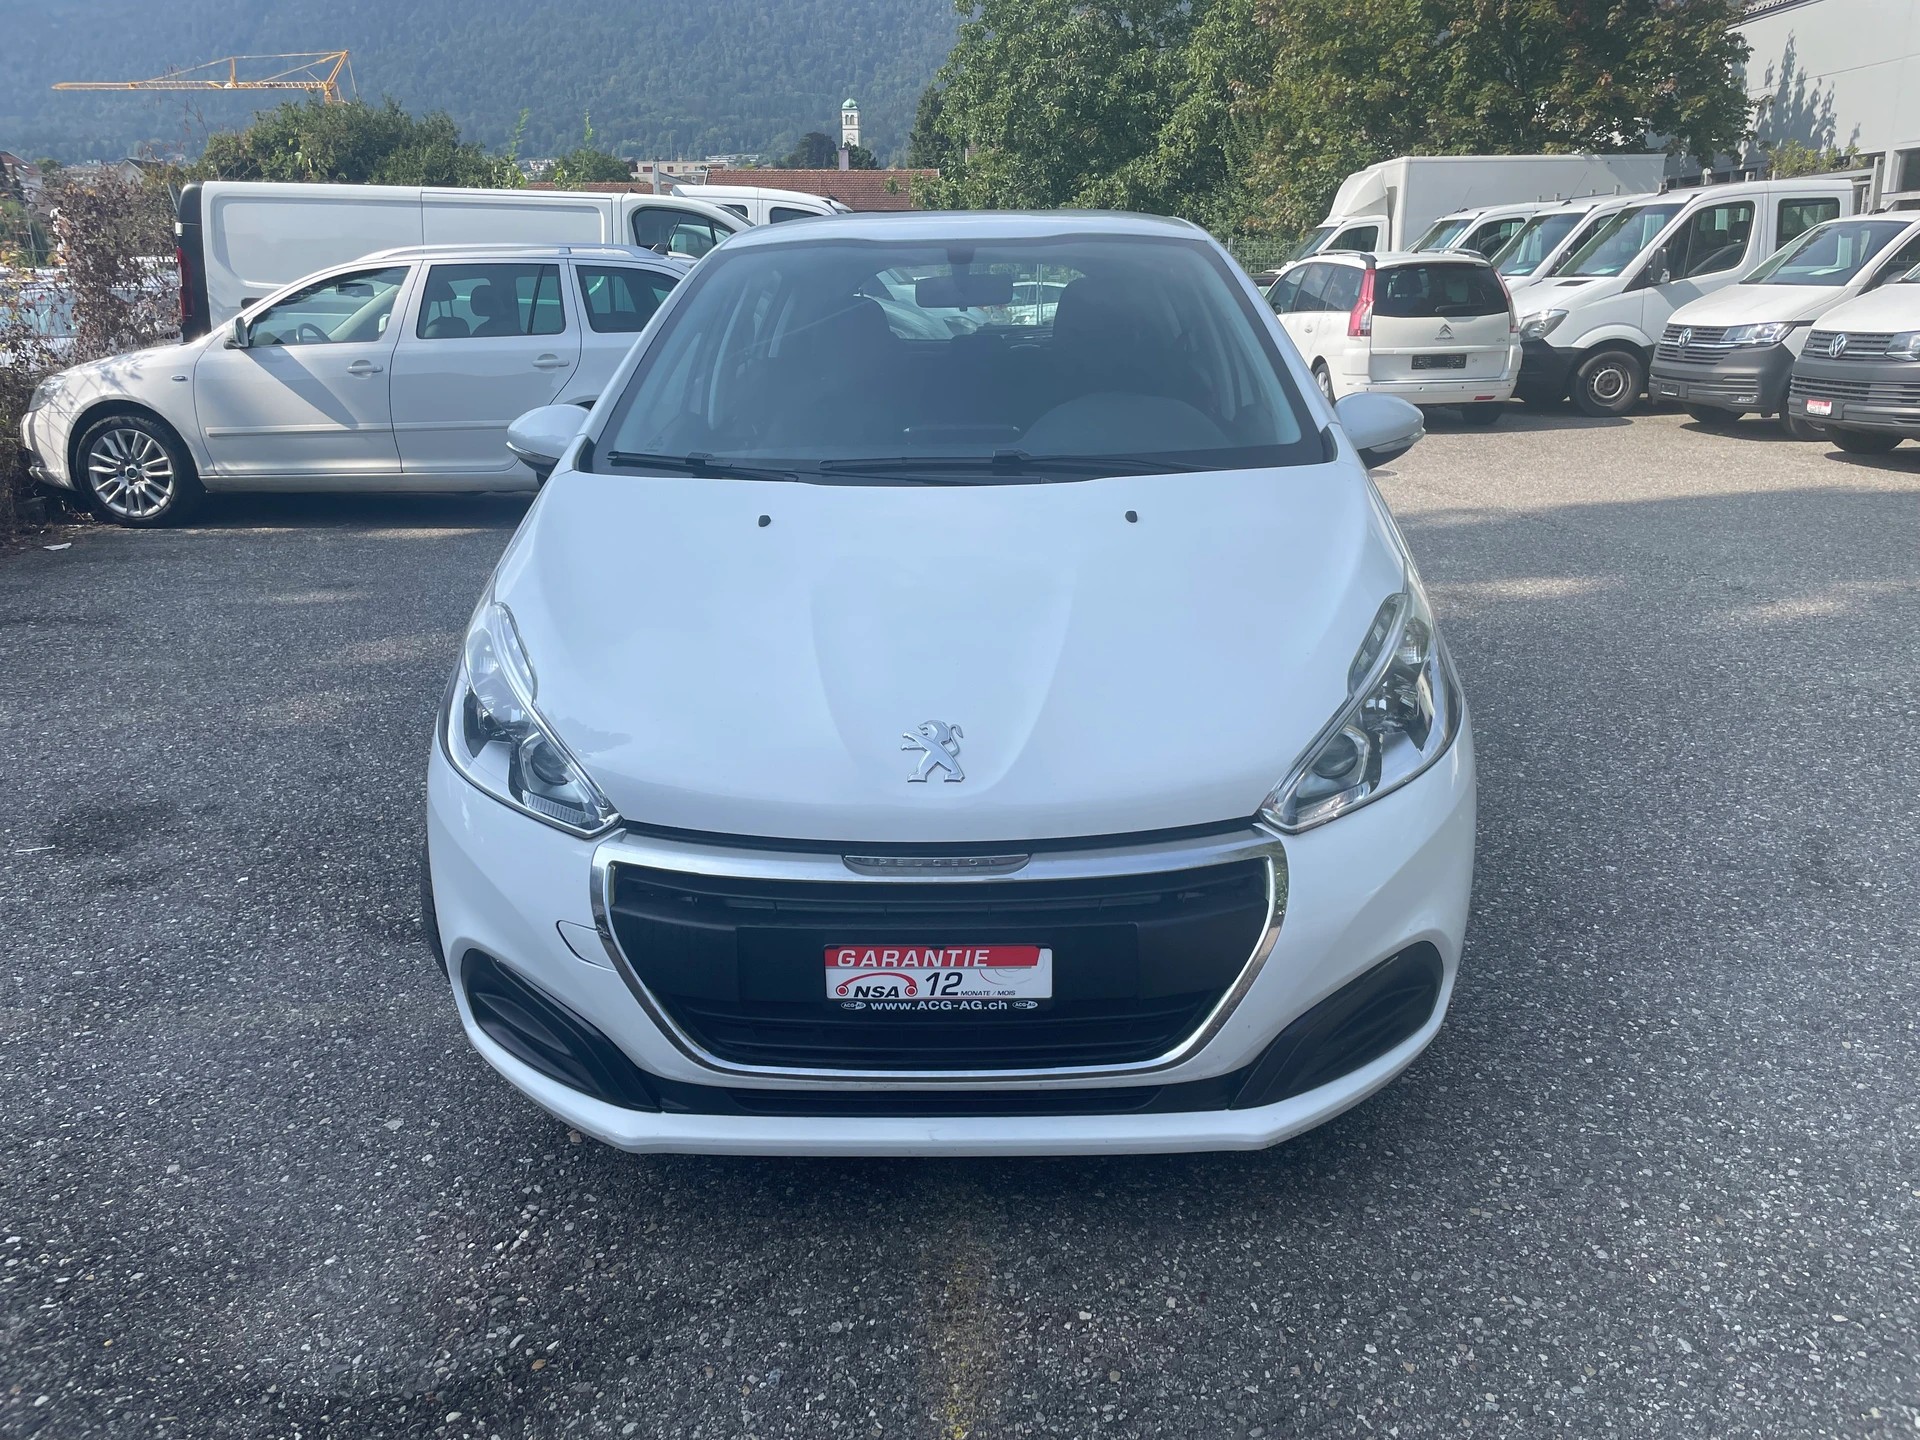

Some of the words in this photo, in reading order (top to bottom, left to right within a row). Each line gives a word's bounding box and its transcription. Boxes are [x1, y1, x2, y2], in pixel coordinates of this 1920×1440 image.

[837, 949, 990, 967] GARANTIE
[925, 971, 964, 996] 12
[853, 985, 900, 998] NSA
[870, 1000, 1008, 1010] www.ACG-AG.ch
